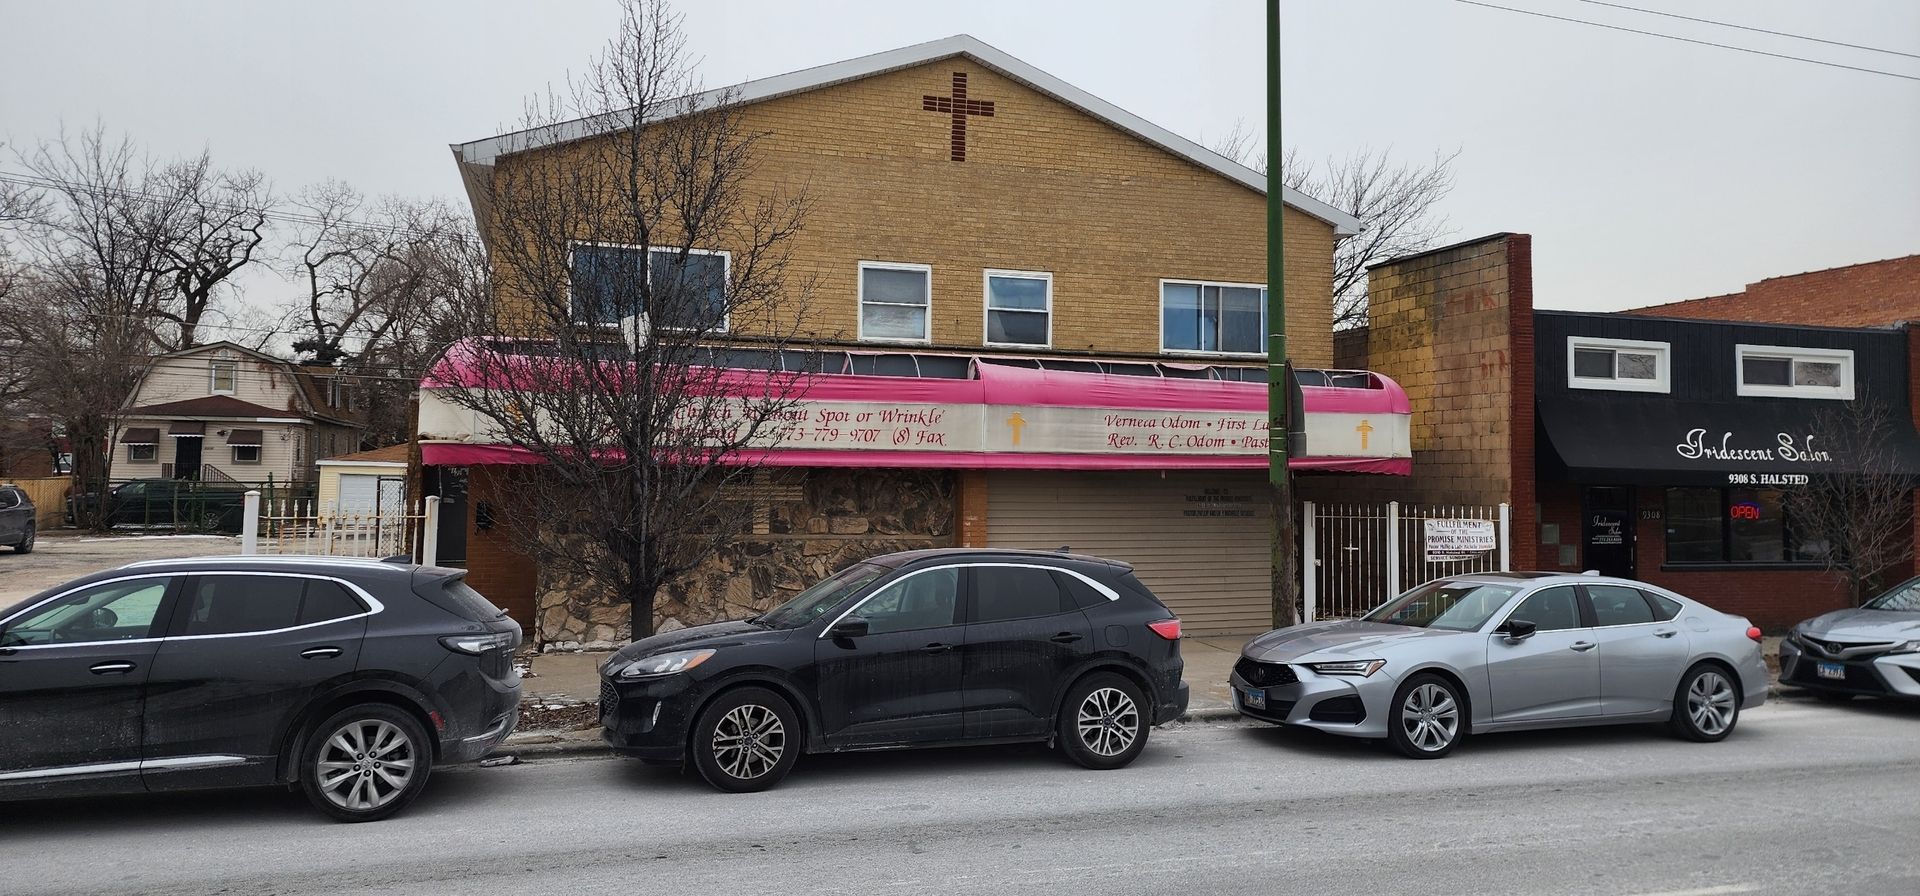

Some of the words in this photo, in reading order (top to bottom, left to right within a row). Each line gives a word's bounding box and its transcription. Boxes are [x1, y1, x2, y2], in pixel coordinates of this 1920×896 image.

[676, 404, 732, 420] Chrch
[816, 408, 850, 427] Spot
[856, 411, 873, 423] or
[1162, 415, 1201, 429] Odom
[1216, 417, 1247, 431] First
[1252, 418, 1269, 431] La
[892, 427, 910, 446] (8)
[1107, 432, 1138, 448] Rev.
[1148, 433, 1164, 449] R.
[1168, 434, 1182, 448] C.
[1186, 434, 1225, 448] Odom
[1241, 434, 1269, 449] Past
[1676, 428, 1775, 461] Iridescent
[1728, 474, 1749, 484] 9308
[1750, 474, 1759, 484] S.
[1760, 474, 1809, 485] HALSTED
[1642, 510, 1661, 520] 9308
[1730, 505, 1760, 520] OPEN
[1428, 535, 1455, 543] PROMISE
[1456, 535, 1494, 543] MINISTRIES
